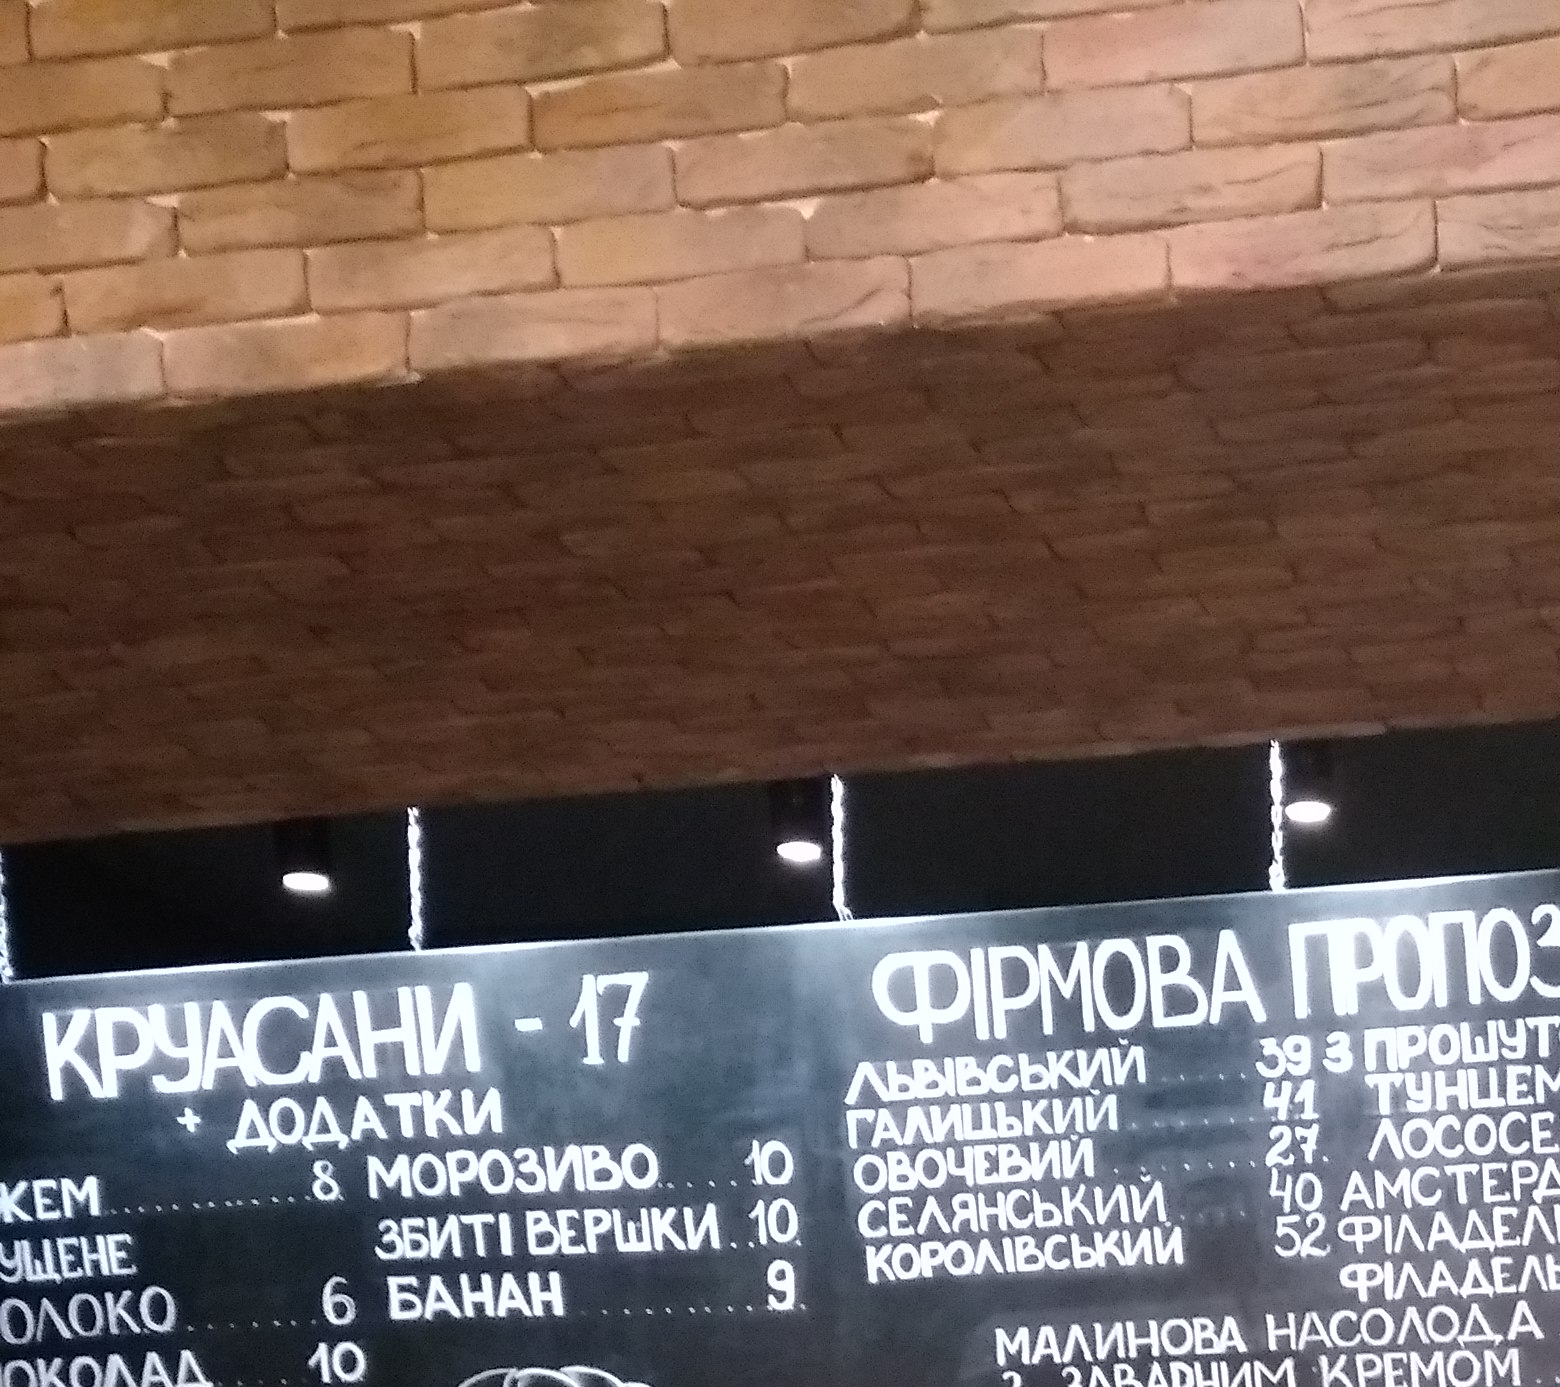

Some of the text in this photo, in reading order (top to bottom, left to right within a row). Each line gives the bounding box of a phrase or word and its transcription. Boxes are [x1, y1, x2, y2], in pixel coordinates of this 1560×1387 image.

[871, 929, 1267, 1043] ФІРМОВА
[41, 981, 481, 1101] КРУАСАНИ
[570, 972, 648, 1065] 17
[844, 1035, 1311, 1106] ЛЬВІВСЬКИЙ 39
[226, 1087, 503, 1154] ДОДАТКИ
[845, 1081, 1319, 1148] ГАЛИЦЬКИЙ 41
[311, 1160, 341, 1200] 8
[367, 1139, 794, 1198] МОРОЗИВО 10
[853, 1125, 1318, 1193] ОВОЧЕВИЙ 27
[375, 1198, 799, 1259] ЗБИТІ ВЕРШКИ 10
[857, 1172, 1322, 1237] СЕЛЯНСЬКИЙ 40
[866, 1215, 1331, 1284] КОРОЛІВСЬКИЙ 52
[321, 1275, 357, 1326] 6
[386, 1259, 795, 1320] БАНАН 9
[308, 1340, 366, 1383] 10
[995, 1316, 1247, 1366] МАЛИНОВА
[1265, 1301, 1544, 1351] НАСОЛОДА
